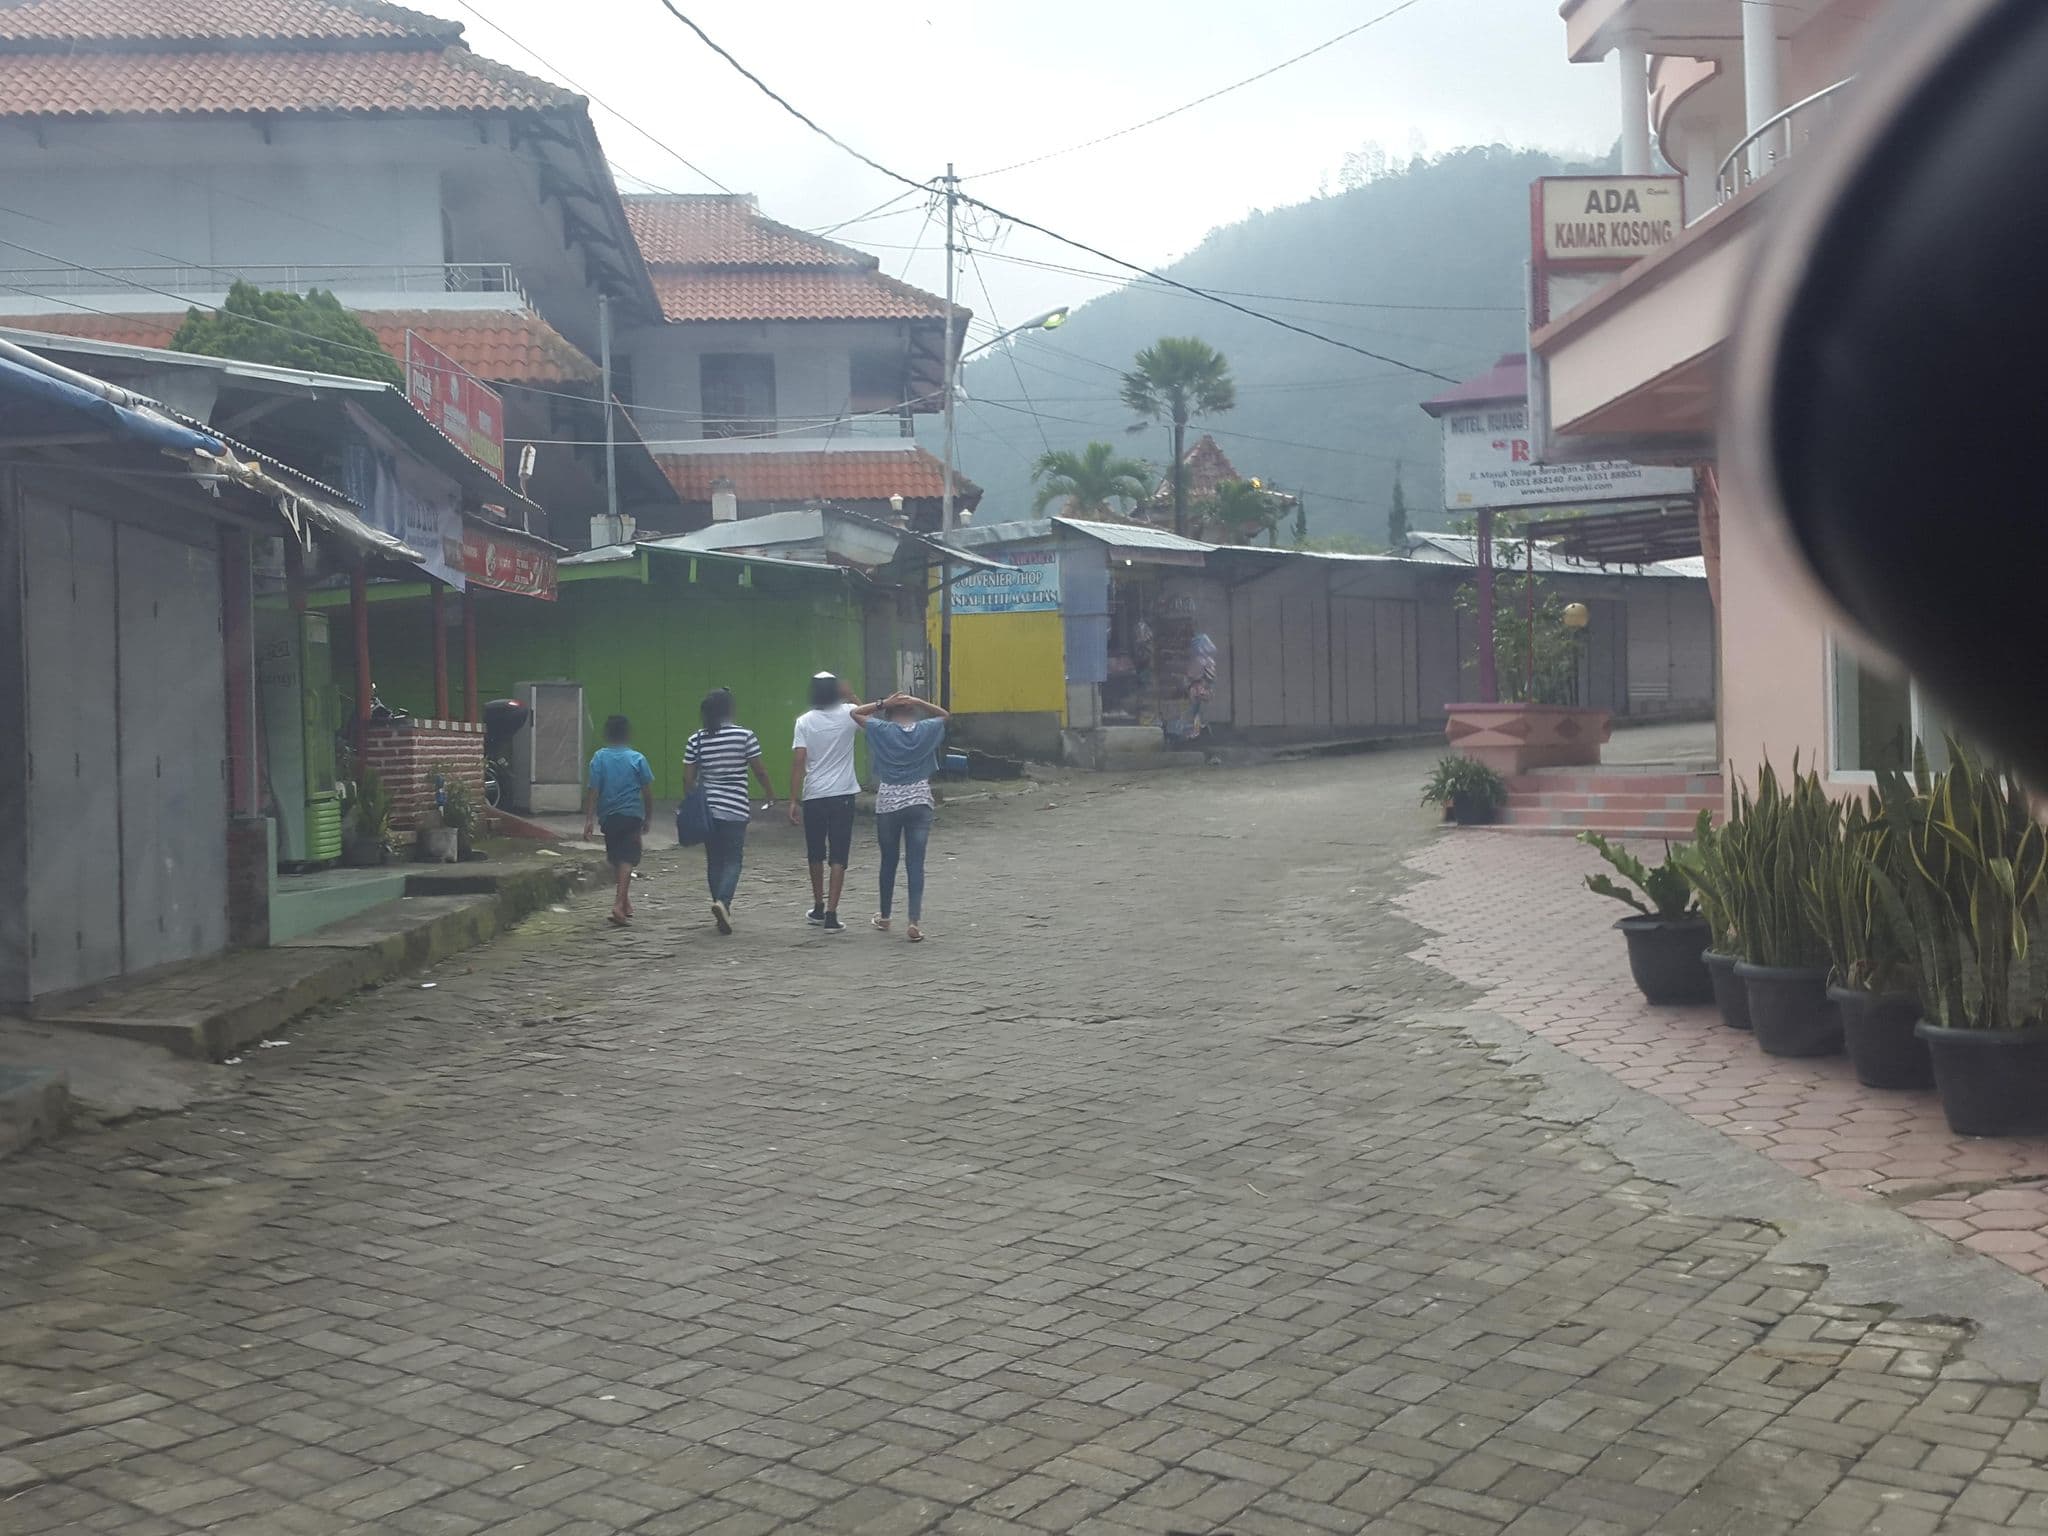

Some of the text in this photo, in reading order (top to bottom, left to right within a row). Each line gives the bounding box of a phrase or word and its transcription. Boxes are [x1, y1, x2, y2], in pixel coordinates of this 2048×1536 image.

[1584, 188, 1641, 214] ADA
[1555, 220, 1673, 248] KAMAR KOSONG
